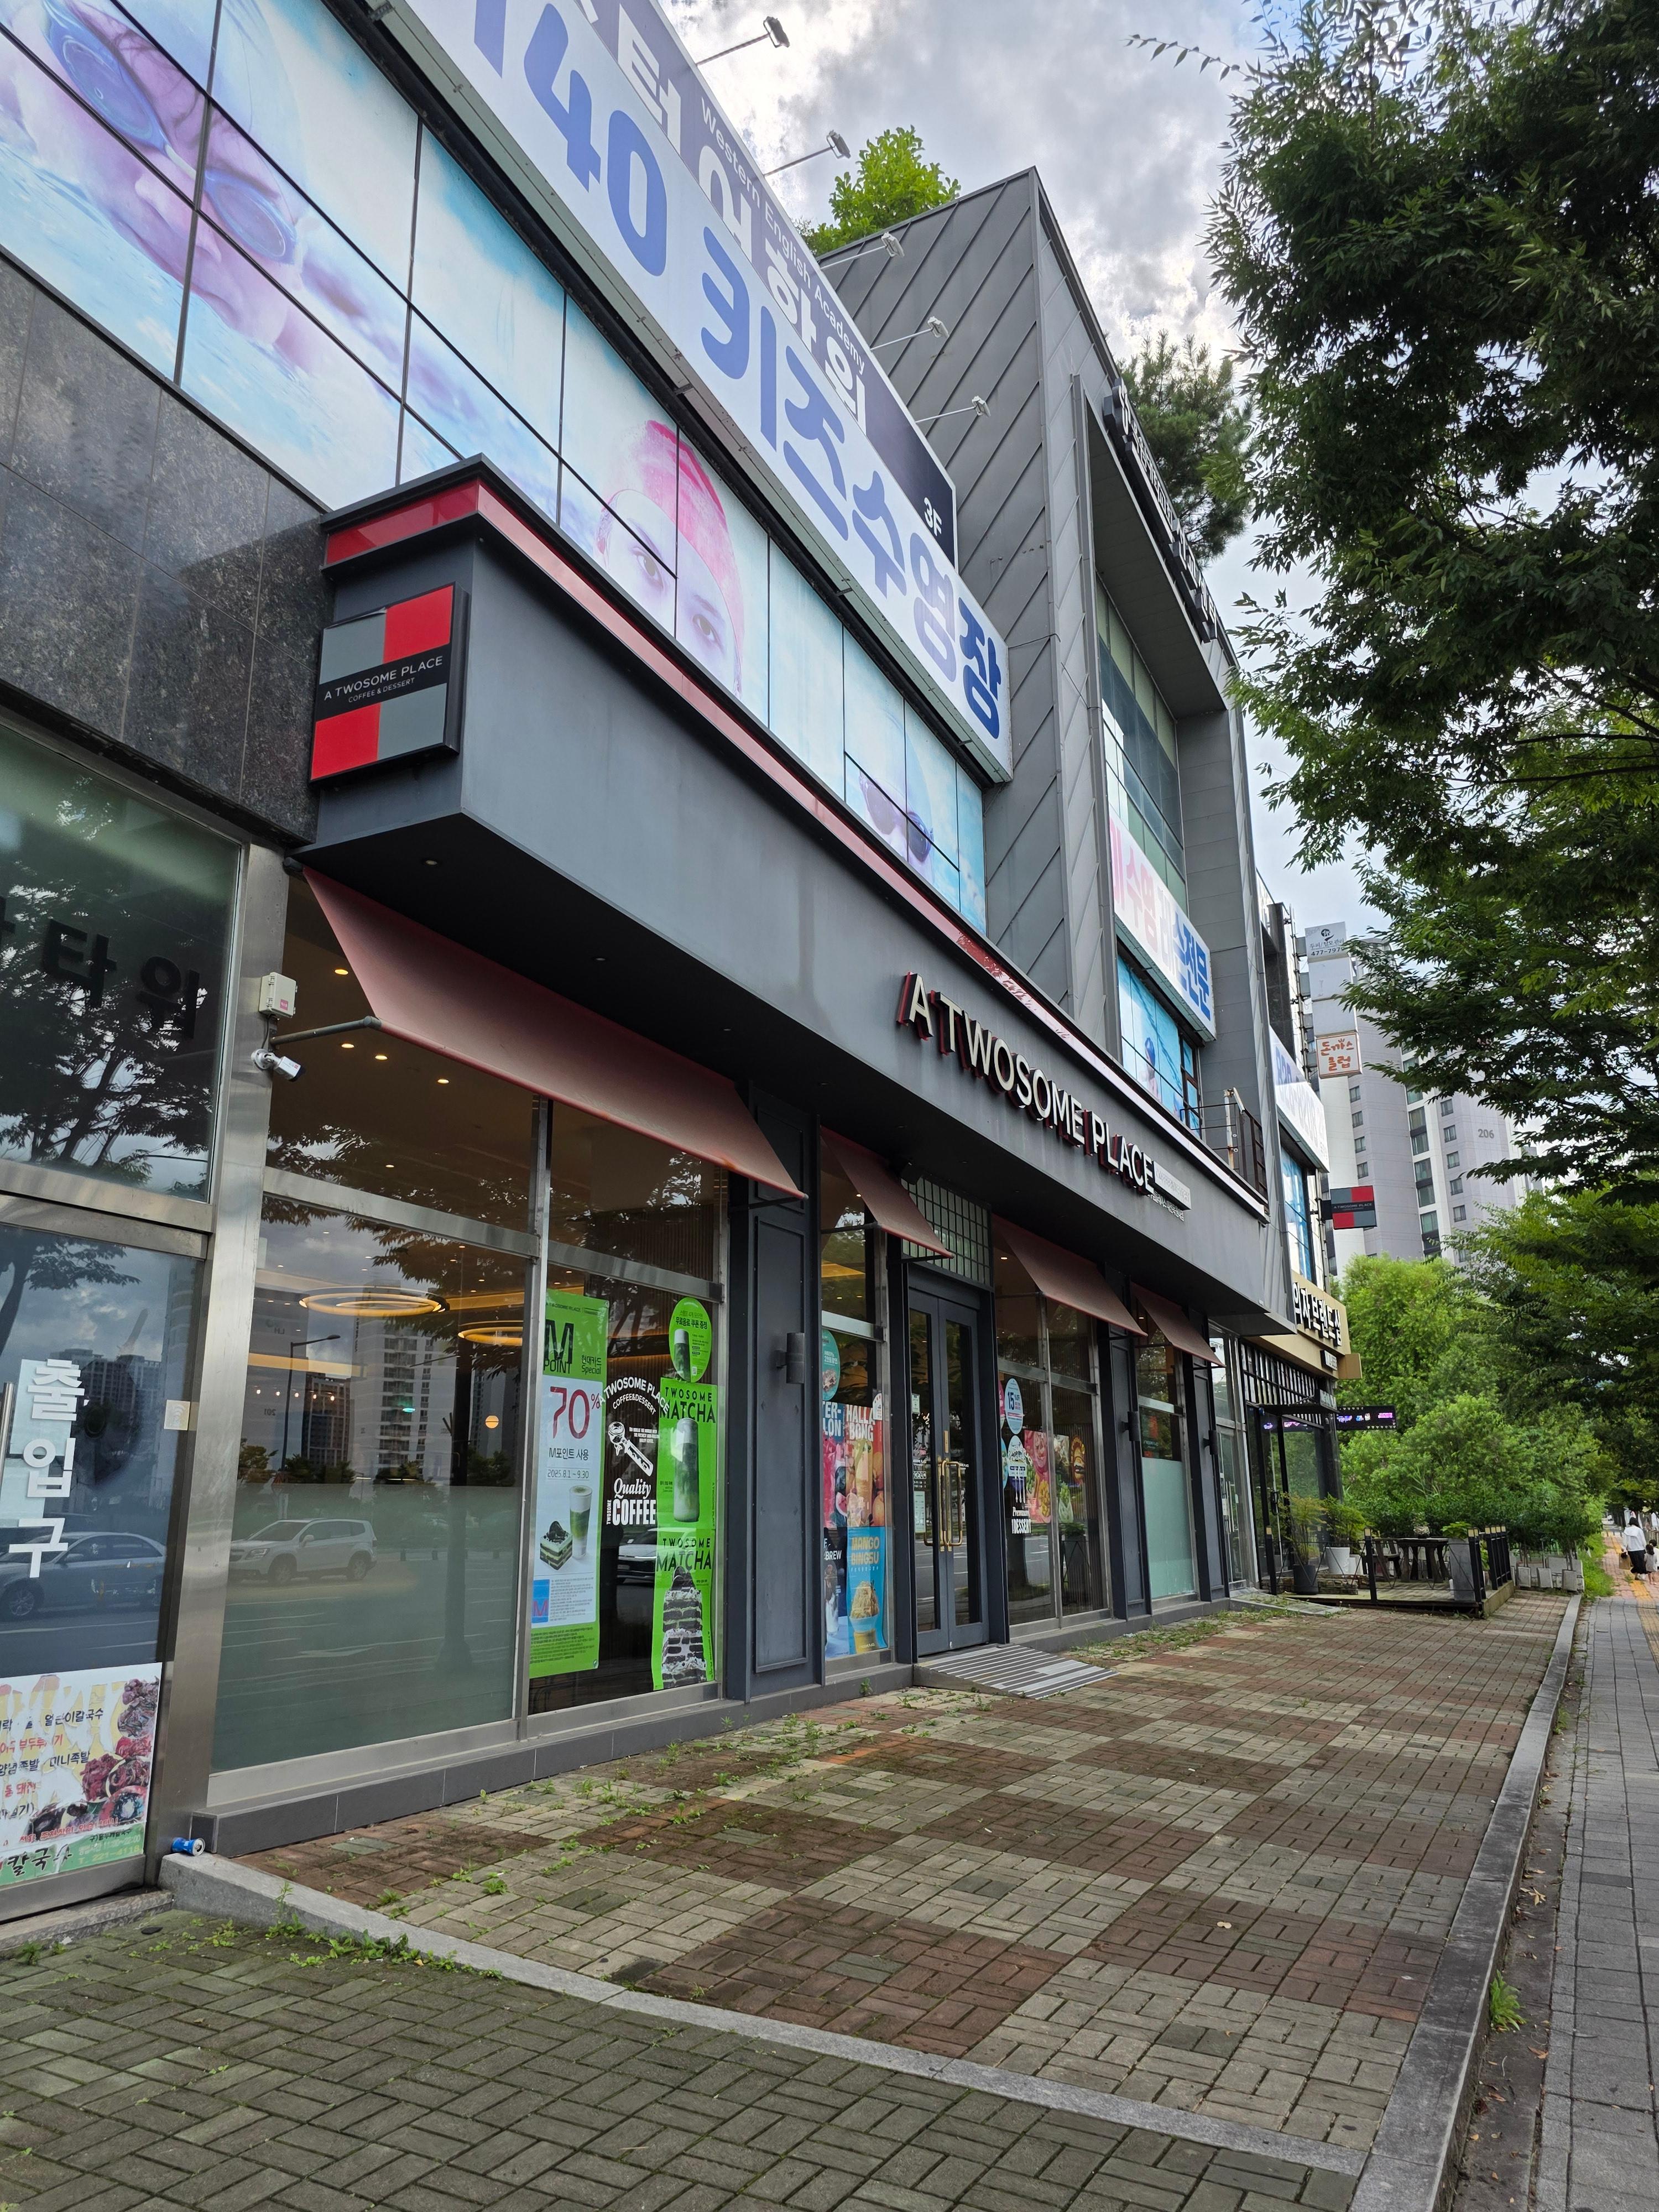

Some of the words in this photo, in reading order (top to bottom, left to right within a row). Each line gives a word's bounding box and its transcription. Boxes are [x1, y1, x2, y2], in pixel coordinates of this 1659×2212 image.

[701, 97, 760, 208] Western
[765, 202, 811, 288] English
[815, 284, 865, 374] Academy
[923, 497, 943, 537] 3F
[324, 691, 332, 701] A
[335, 670, 397, 697] TWOSOME
[401, 656, 443, 676] PLACE
[348, 690, 375, 703] COFFEE
[383, 677, 415, 692] DESSERT
[1321, 1041, 1354, 1057] 돈까스
[1328, 1056, 1350, 1071] 클럽
[902, 972, 933, 1038] A
[936, 991, 1085, 1146] TWOSOME
[1087, 1109, 1154, 1194] PLACE
[1478, 1128, 1495, 1139] 206
[545, 1319, 574, 1364] M
[544, 1359, 571, 1374] POINT
[581, 1355, 602, 1366] 현대카드
[581, 1365, 601, 1375] Special
[599, 1397, 606, 1406] A
[603, 1377, 646, 1399] TWOSOME
[647, 1383, 670, 1414] PLACE
[665, 1387, 712, 1402] TWOSOME
[1008, 1391, 1015, 1411] 15
[660, 1401, 716, 1423] MATCHA
[846, 1404, 875, 1425] HALLA
[849, 1422, 874, 1442] BONG
[576, 1449, 589, 1460] 사용
[9, 1359, 85, 1577] 출입구
[614, 1478, 651, 1499] Quality
[612, 1499, 656, 1525] COFFEE
[663, 1538, 711, 1548] TWOSOME
[851, 1537, 880, 1550] MANGO
[656, 1550, 712, 1572] MATCHA
[825, 1550, 842, 1561] BREW
[851, 1552, 879, 1566] BINGSU
